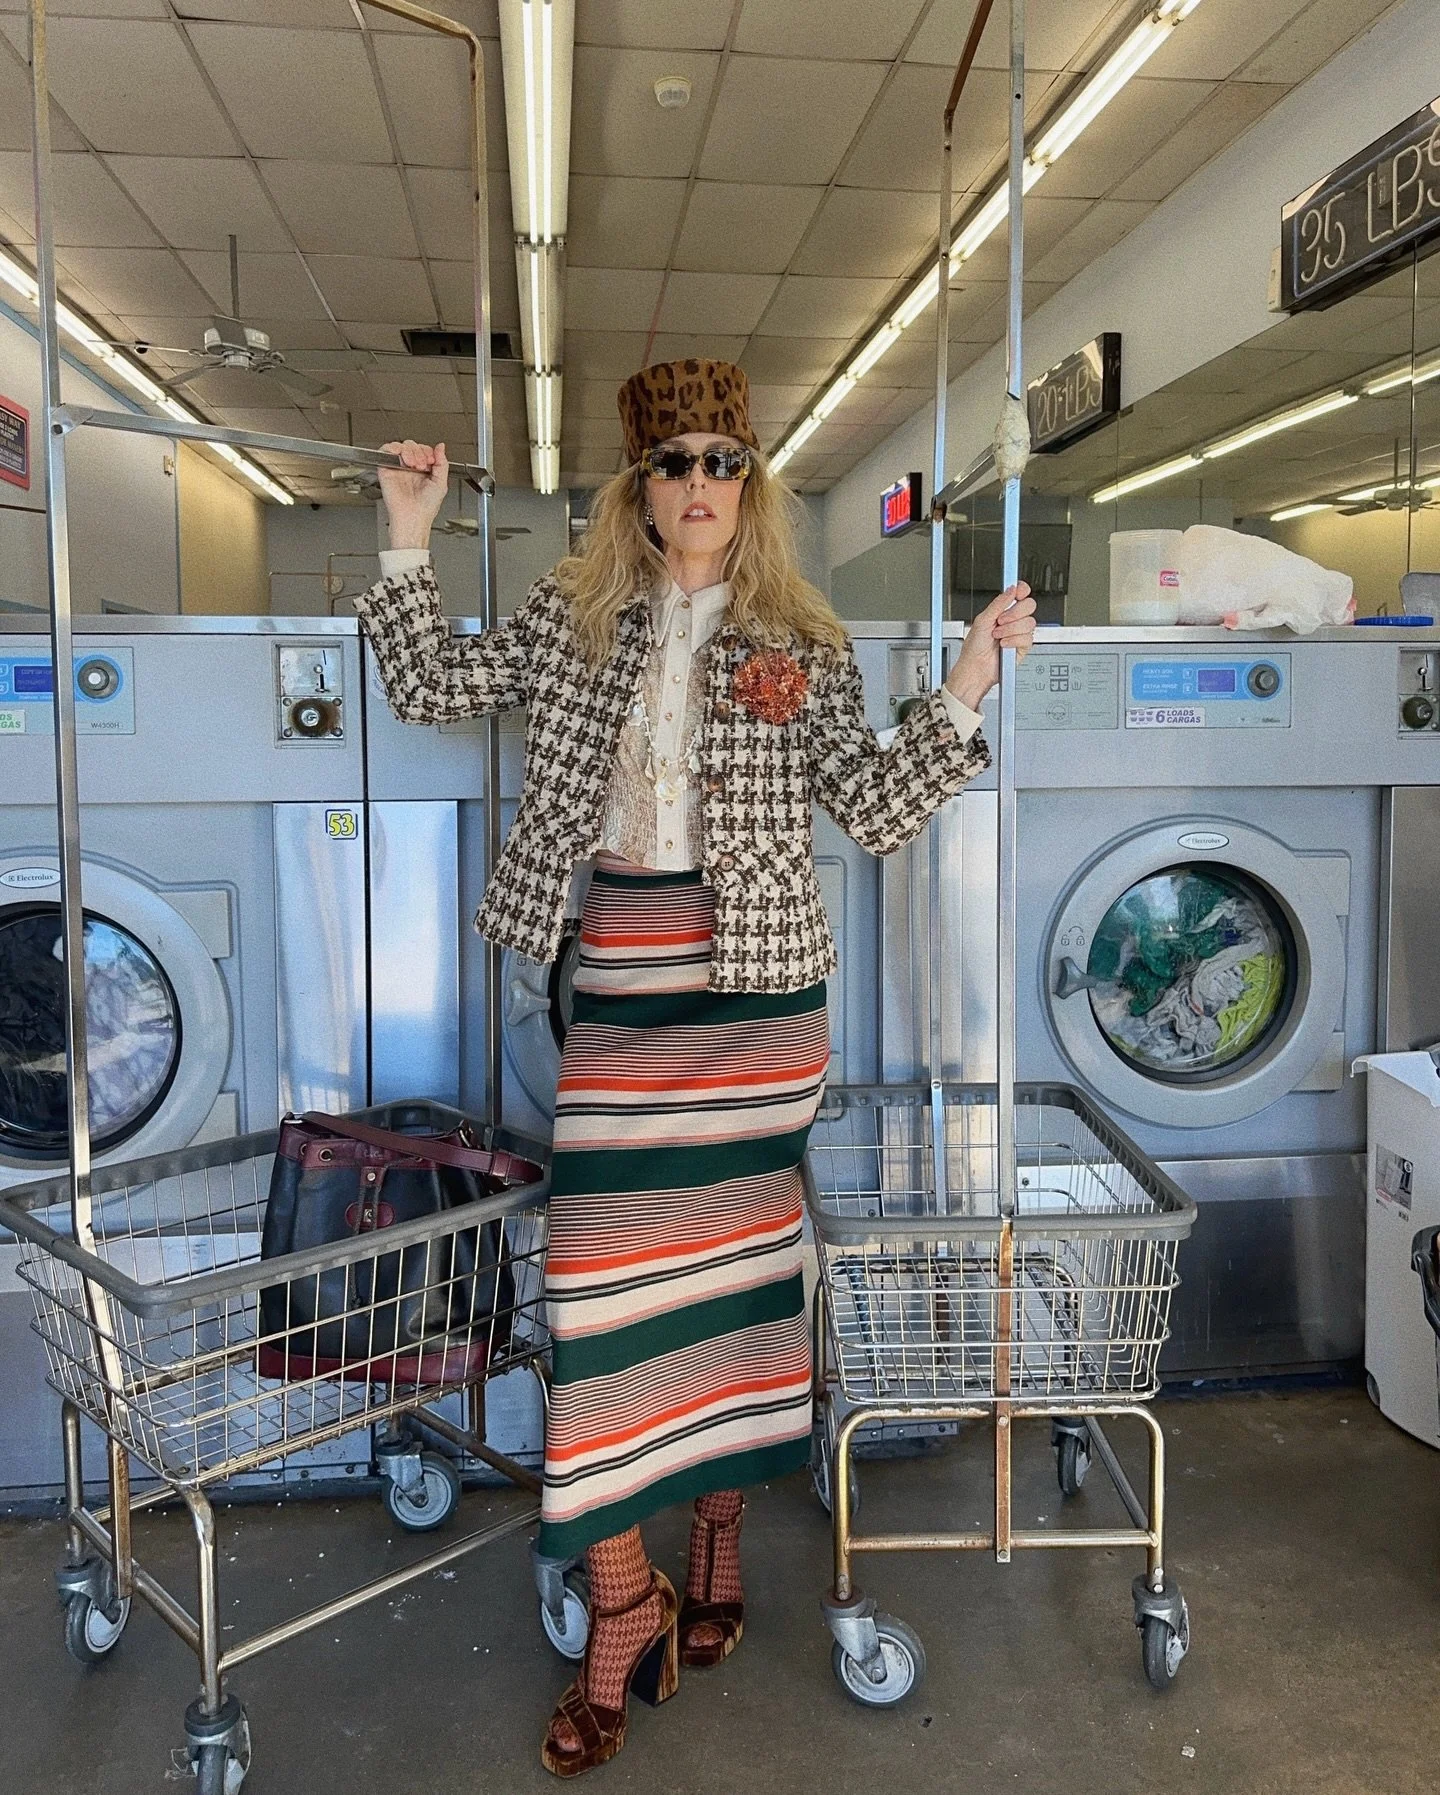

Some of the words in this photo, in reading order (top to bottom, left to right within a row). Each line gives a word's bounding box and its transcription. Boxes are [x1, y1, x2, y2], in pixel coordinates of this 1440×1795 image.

[1301, 191, 1346, 283] 35
[1037, 384, 1058, 438] 20
[1155, 709, 1165, 724] 6
[1166, 709, 1195, 717] LOADS
[1166, 716, 1202, 724] CARGAS
[328, 812, 355, 837] 53
[16, 873, 54, 882] Electrolux
